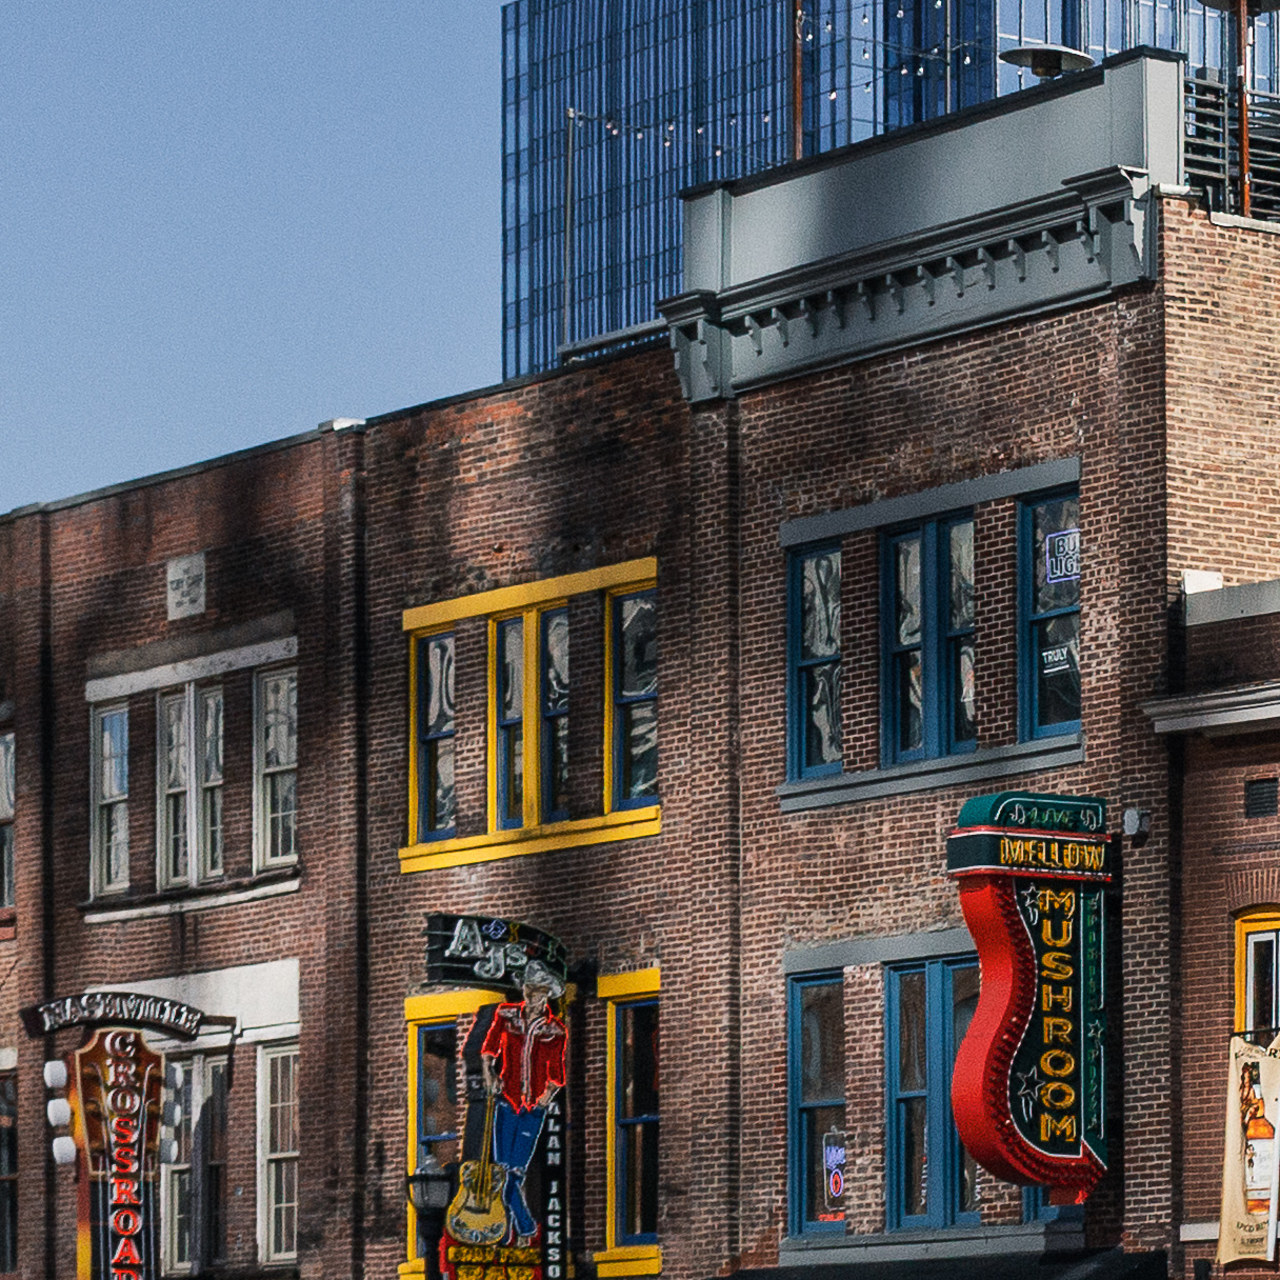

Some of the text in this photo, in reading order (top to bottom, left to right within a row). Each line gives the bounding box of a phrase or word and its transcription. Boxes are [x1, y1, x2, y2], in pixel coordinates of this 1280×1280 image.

[1000, 836, 1105, 869] MELLOW
[1039, 889, 1077, 1142] MUSHROOM
[547, 1101, 561, 1166] ALAN
